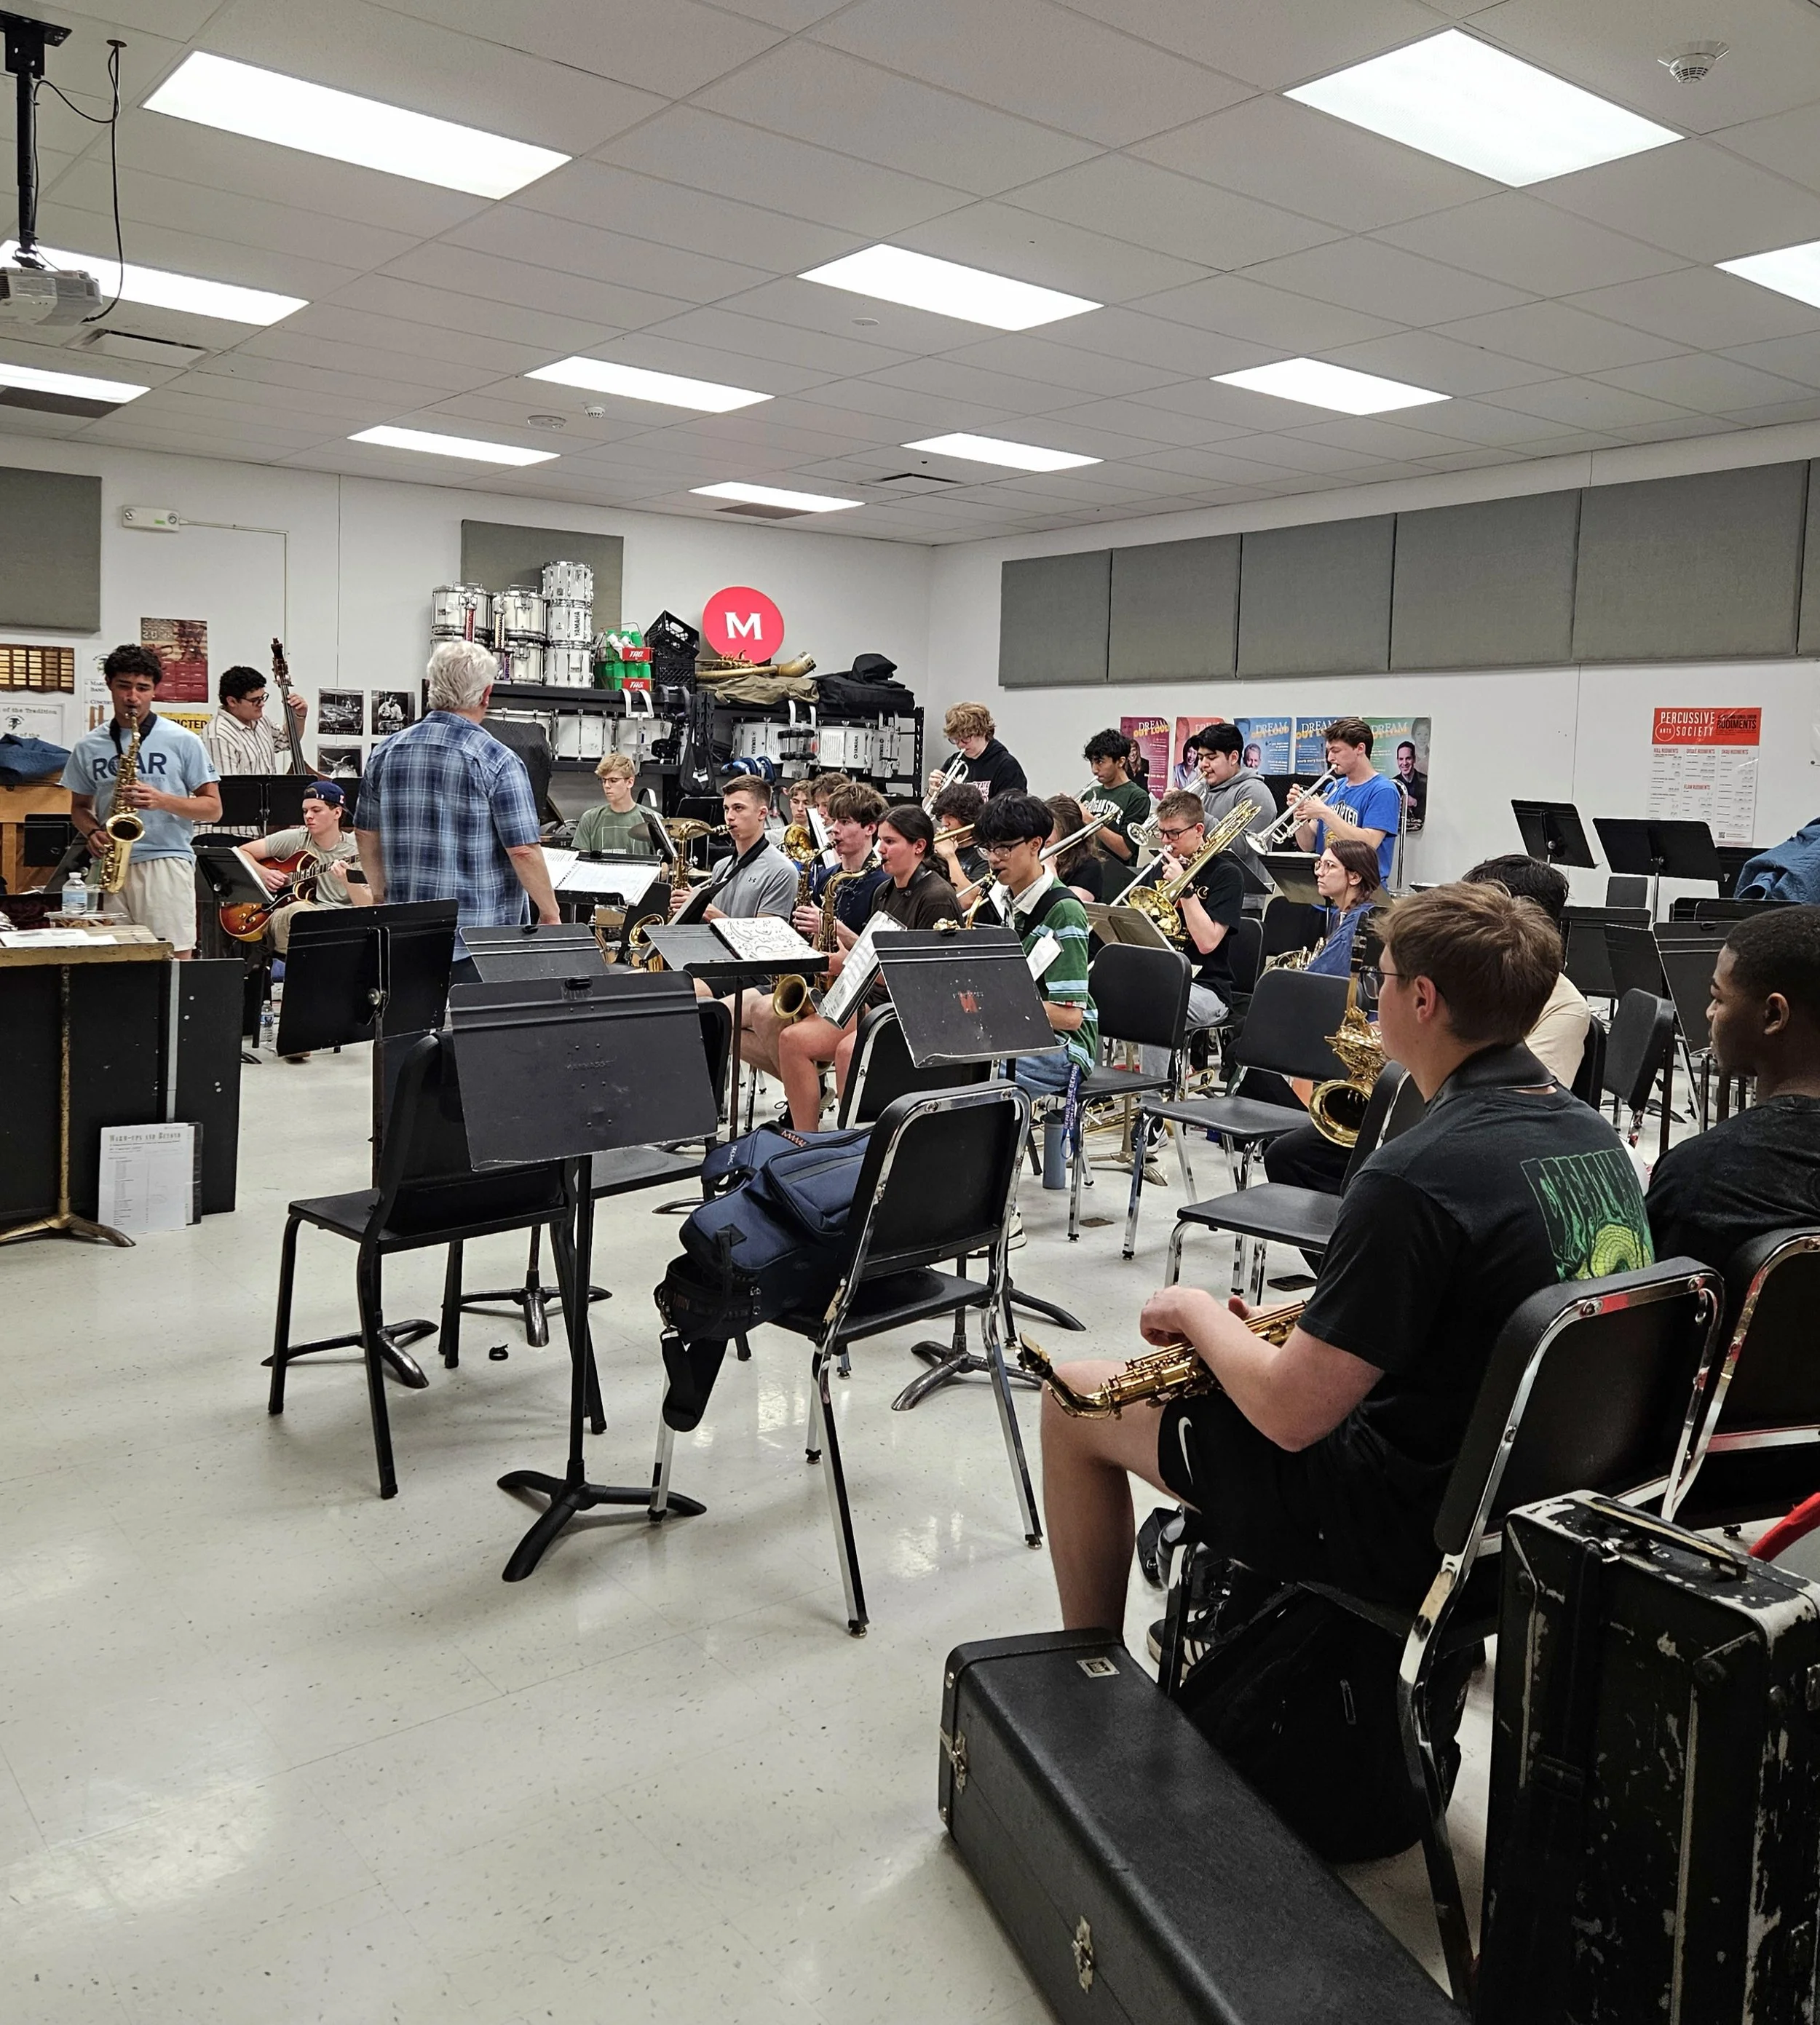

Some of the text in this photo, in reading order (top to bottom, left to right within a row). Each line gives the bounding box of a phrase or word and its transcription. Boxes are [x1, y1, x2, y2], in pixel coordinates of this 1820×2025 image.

[574, 611, 582, 637] YAMAHA
[724, 611, 763, 640] M
[1661, 711, 1715, 724] PERCUSSIVE
[1717, 719, 1757, 729] RUDIMENTS
[1676, 726, 1714, 737] SOCIETY
[92, 752, 167, 781] ROAR
